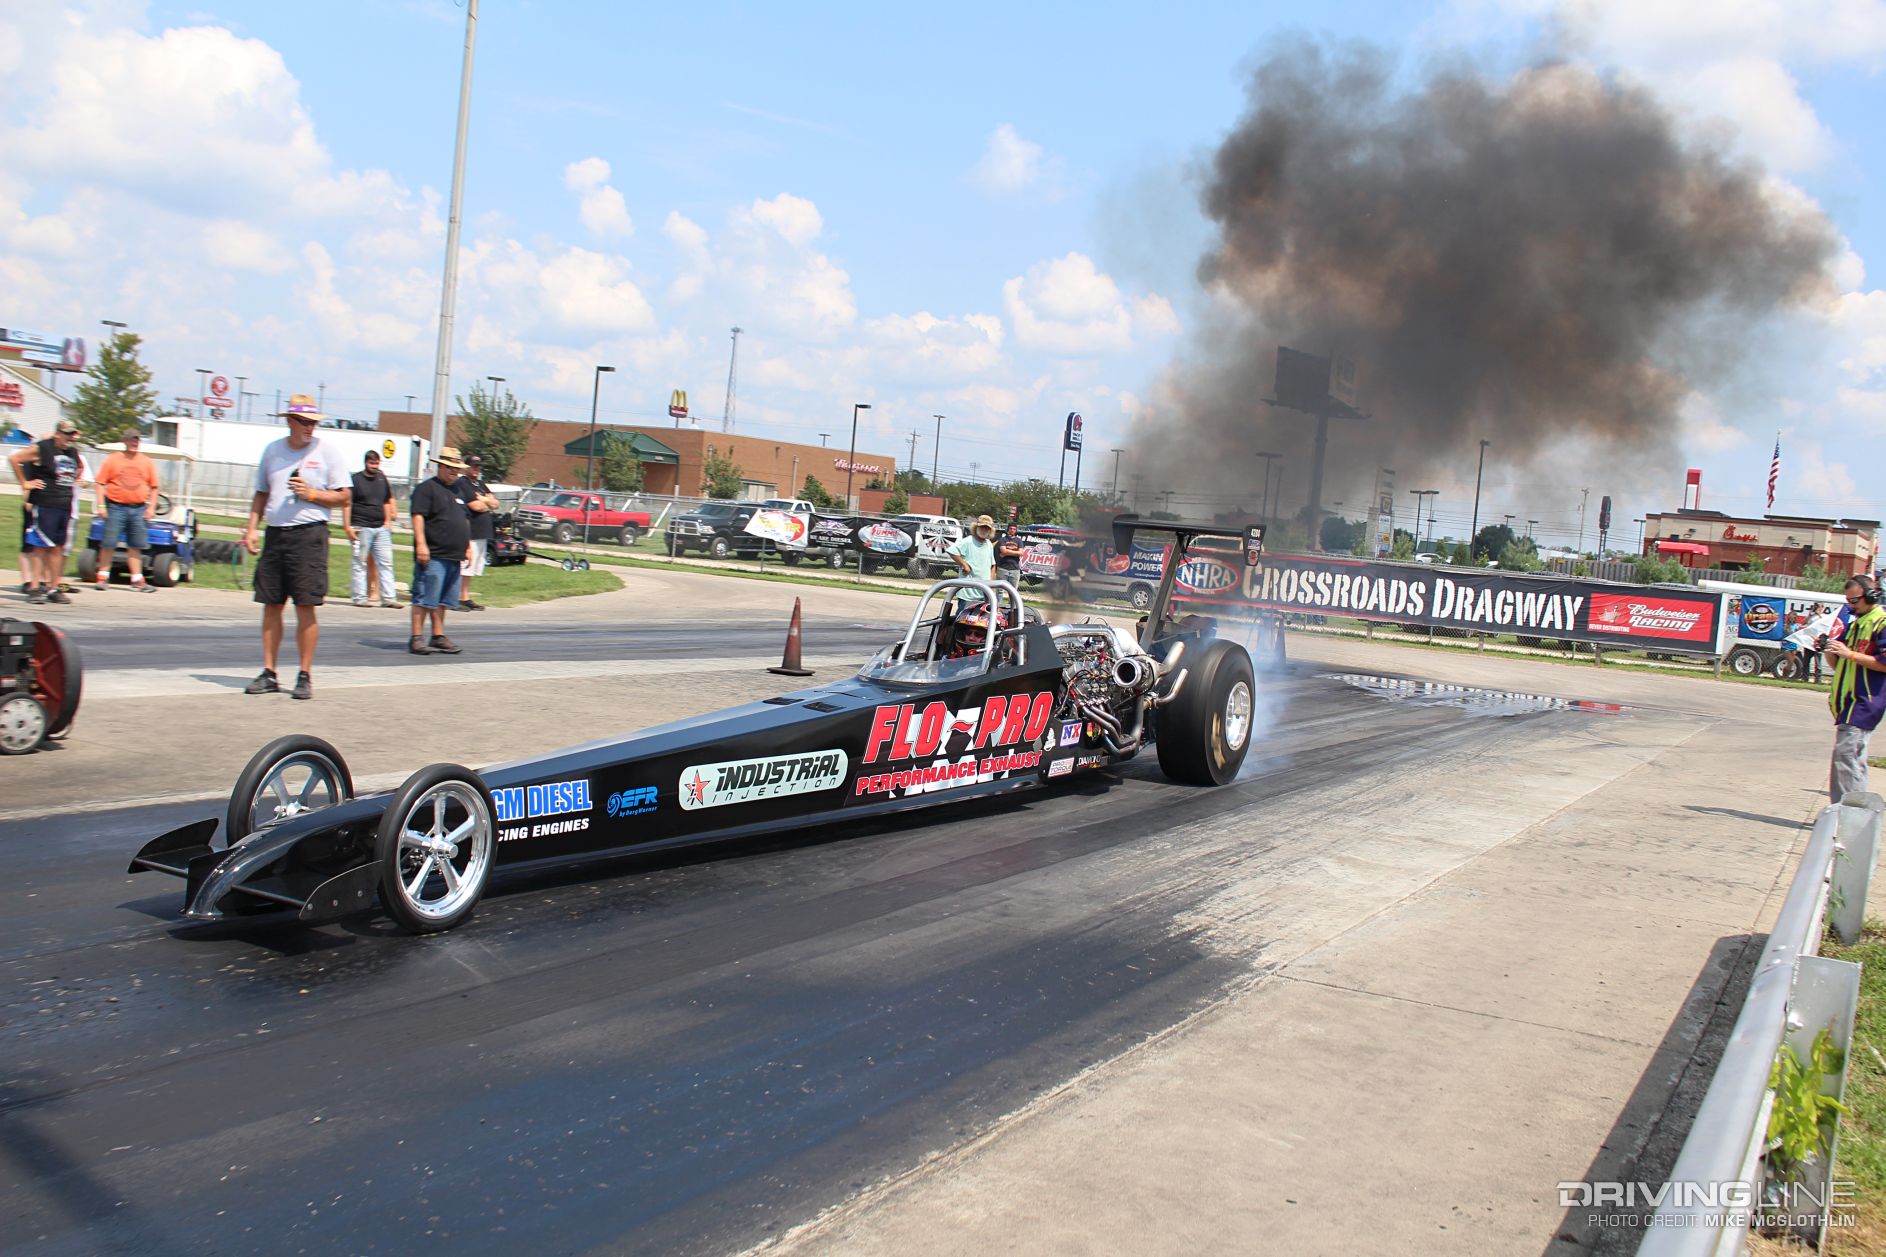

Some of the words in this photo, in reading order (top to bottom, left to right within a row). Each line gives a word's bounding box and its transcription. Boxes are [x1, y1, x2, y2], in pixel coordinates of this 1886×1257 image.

[1130, 561, 1163, 572] POWER
[1181, 563, 1231, 588] NHRA
[1242, 562, 1426, 616] CROSSROADS
[1431, 578, 1584, 631] DRAGWAY
[1627, 603, 1702, 619] Budweiser
[1062, 724, 1081, 740] NX
[855, 761, 977, 796] PERFORMANCE
[978, 750, 1043, 775] EXHAUST
[527, 779, 593, 819] DIESEL
[620, 786, 658, 808] EFR
[532, 818, 590, 838] ENGINES
